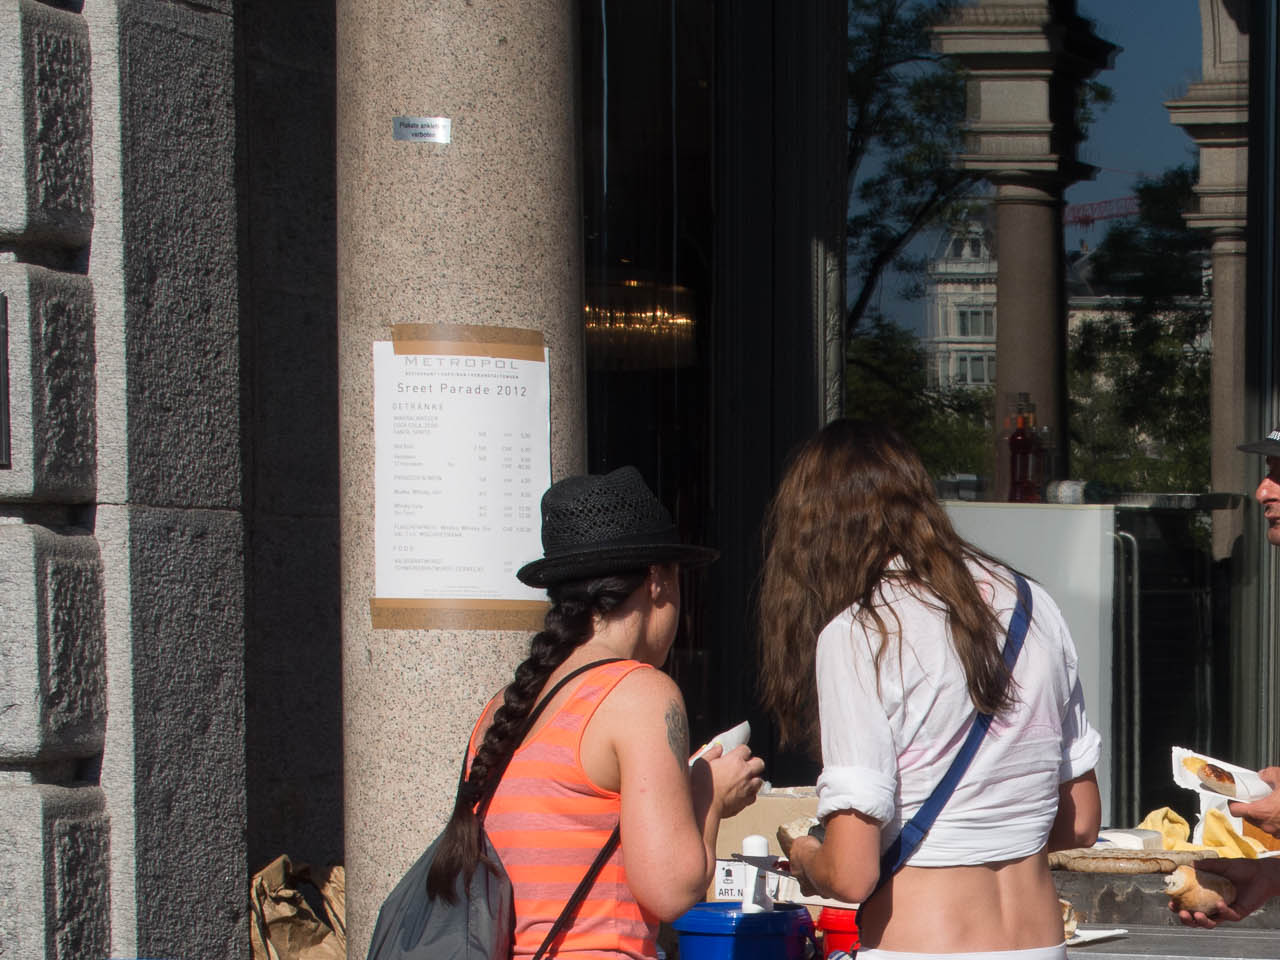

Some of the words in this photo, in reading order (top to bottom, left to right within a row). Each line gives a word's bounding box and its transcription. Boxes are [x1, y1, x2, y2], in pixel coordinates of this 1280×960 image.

[404, 355, 520, 370] METROPOL
[397, 382, 433, 394] Sreet
[440, 383, 490, 395] Parade
[496, 385, 528, 397] 2012
[718, 888, 736, 897] ART.
